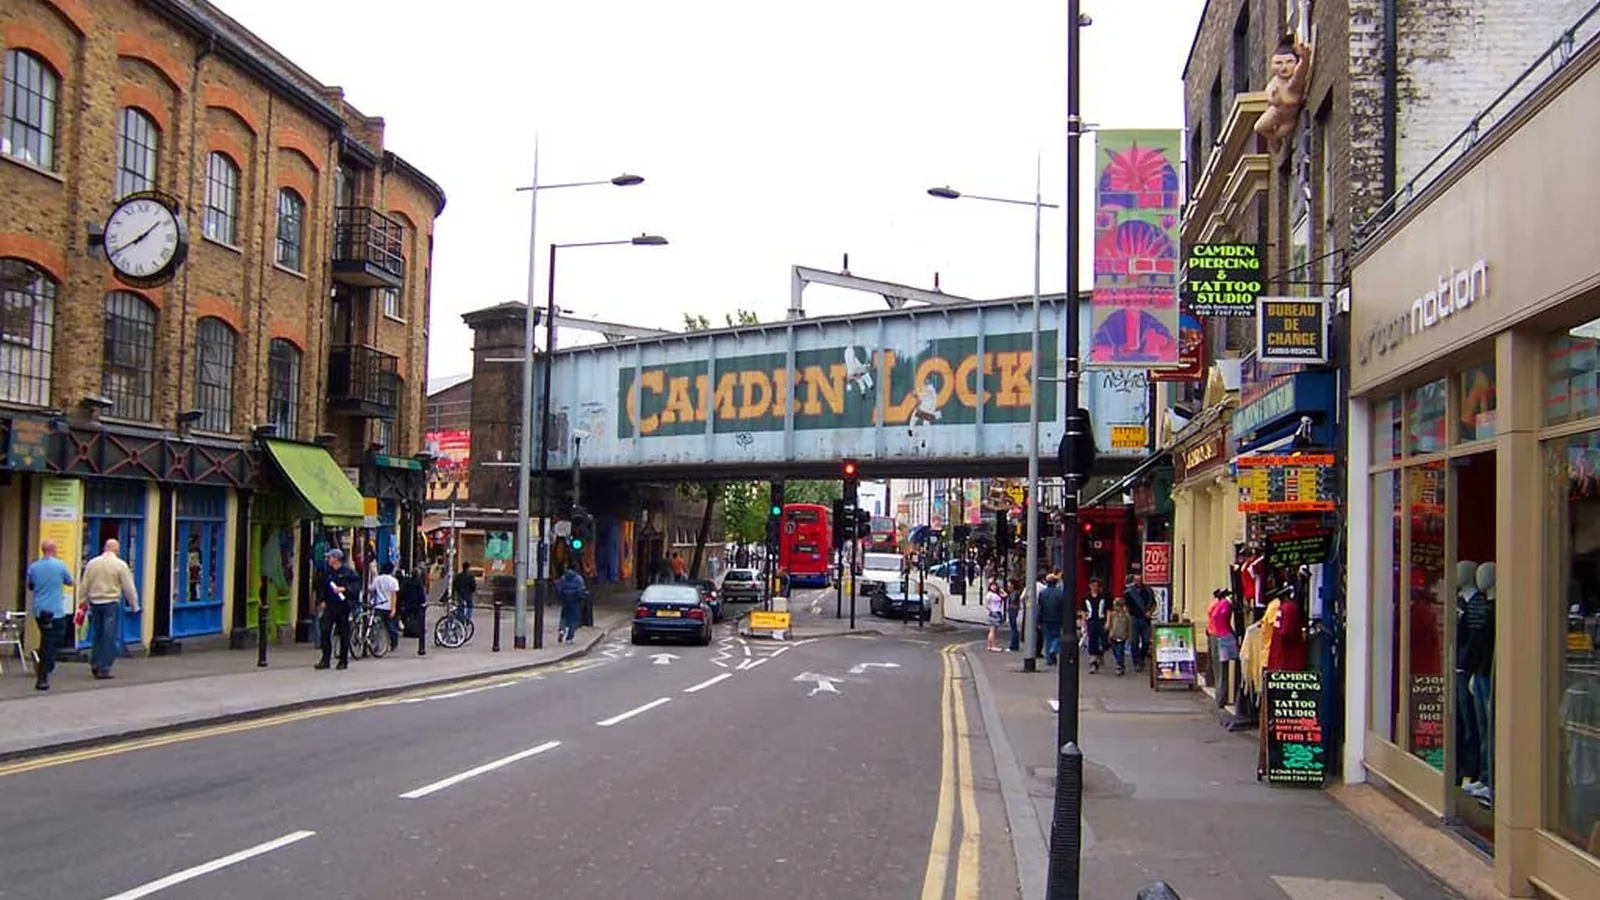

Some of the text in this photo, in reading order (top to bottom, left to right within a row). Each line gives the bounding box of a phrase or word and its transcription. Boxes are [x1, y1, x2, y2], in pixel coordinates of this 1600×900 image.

[1193, 245, 1255, 256] CAMDEN
[1189, 258, 1259, 269] PIERCING
[1216, 270, 1227, 280] &
[1190, 281, 1261, 292] TATTOO
[1197, 293, 1252, 304] STUDIO
[1267, 304, 1316, 316] BUREAU
[1284, 318, 1300, 331] DE
[1267, 332, 1317, 345] CHANGE
[627, 350, 1033, 434] CAMDEN LOCK
[1145, 550, 1168, 564] 70%
[1145, 564, 1167, 572] OFF
[1271, 672, 1317, 680] CAMDEN
[1268, 681, 1320, 690] PIERCING
[1291, 690, 1299, 699] &
[1274, 700, 1316, 708] TATTOO
[1274, 709, 1316, 717] STUDIO
